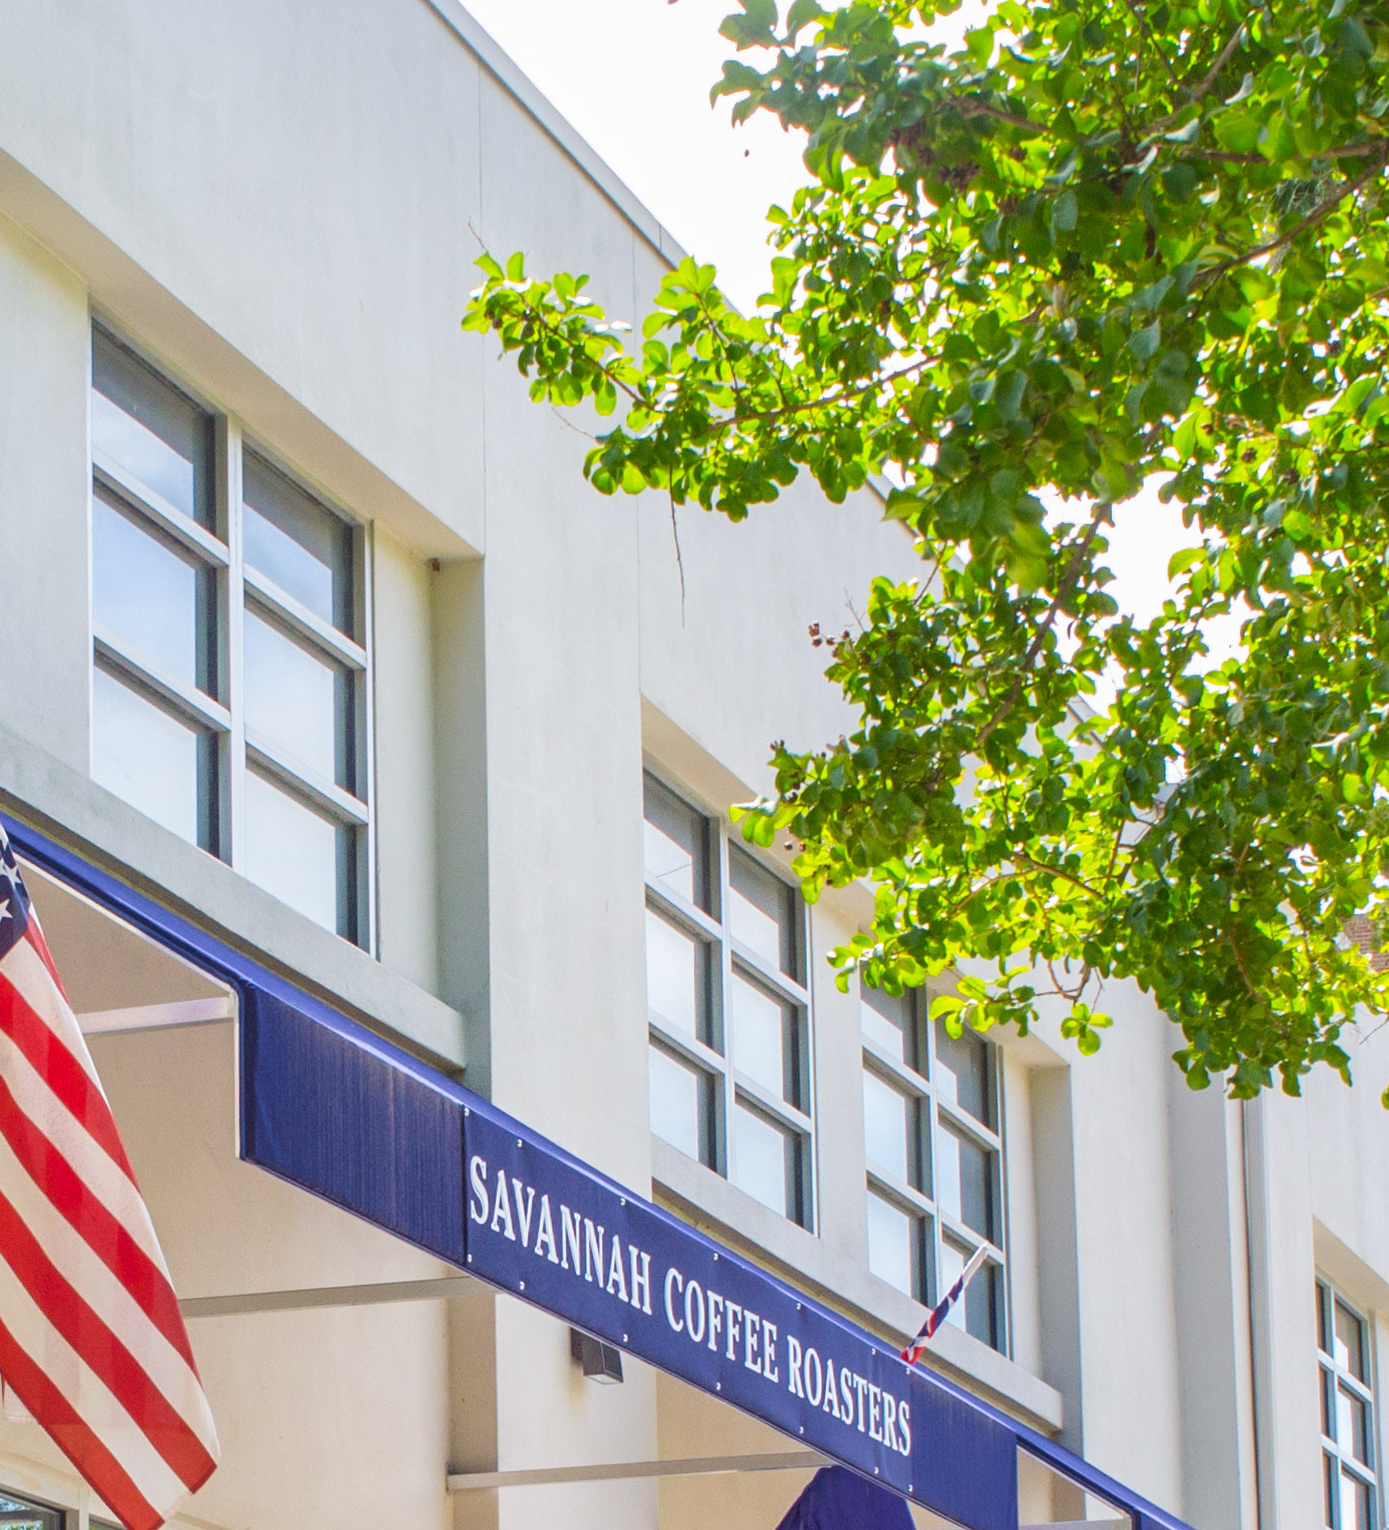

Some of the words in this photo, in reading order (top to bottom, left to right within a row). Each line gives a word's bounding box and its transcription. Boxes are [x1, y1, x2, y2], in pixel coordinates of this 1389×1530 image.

[469, 1154, 653, 1316] SAVANNAH
[664, 1267, 780, 1384] COFFEE
[787, 1334, 911, 1457] ROASTERS
